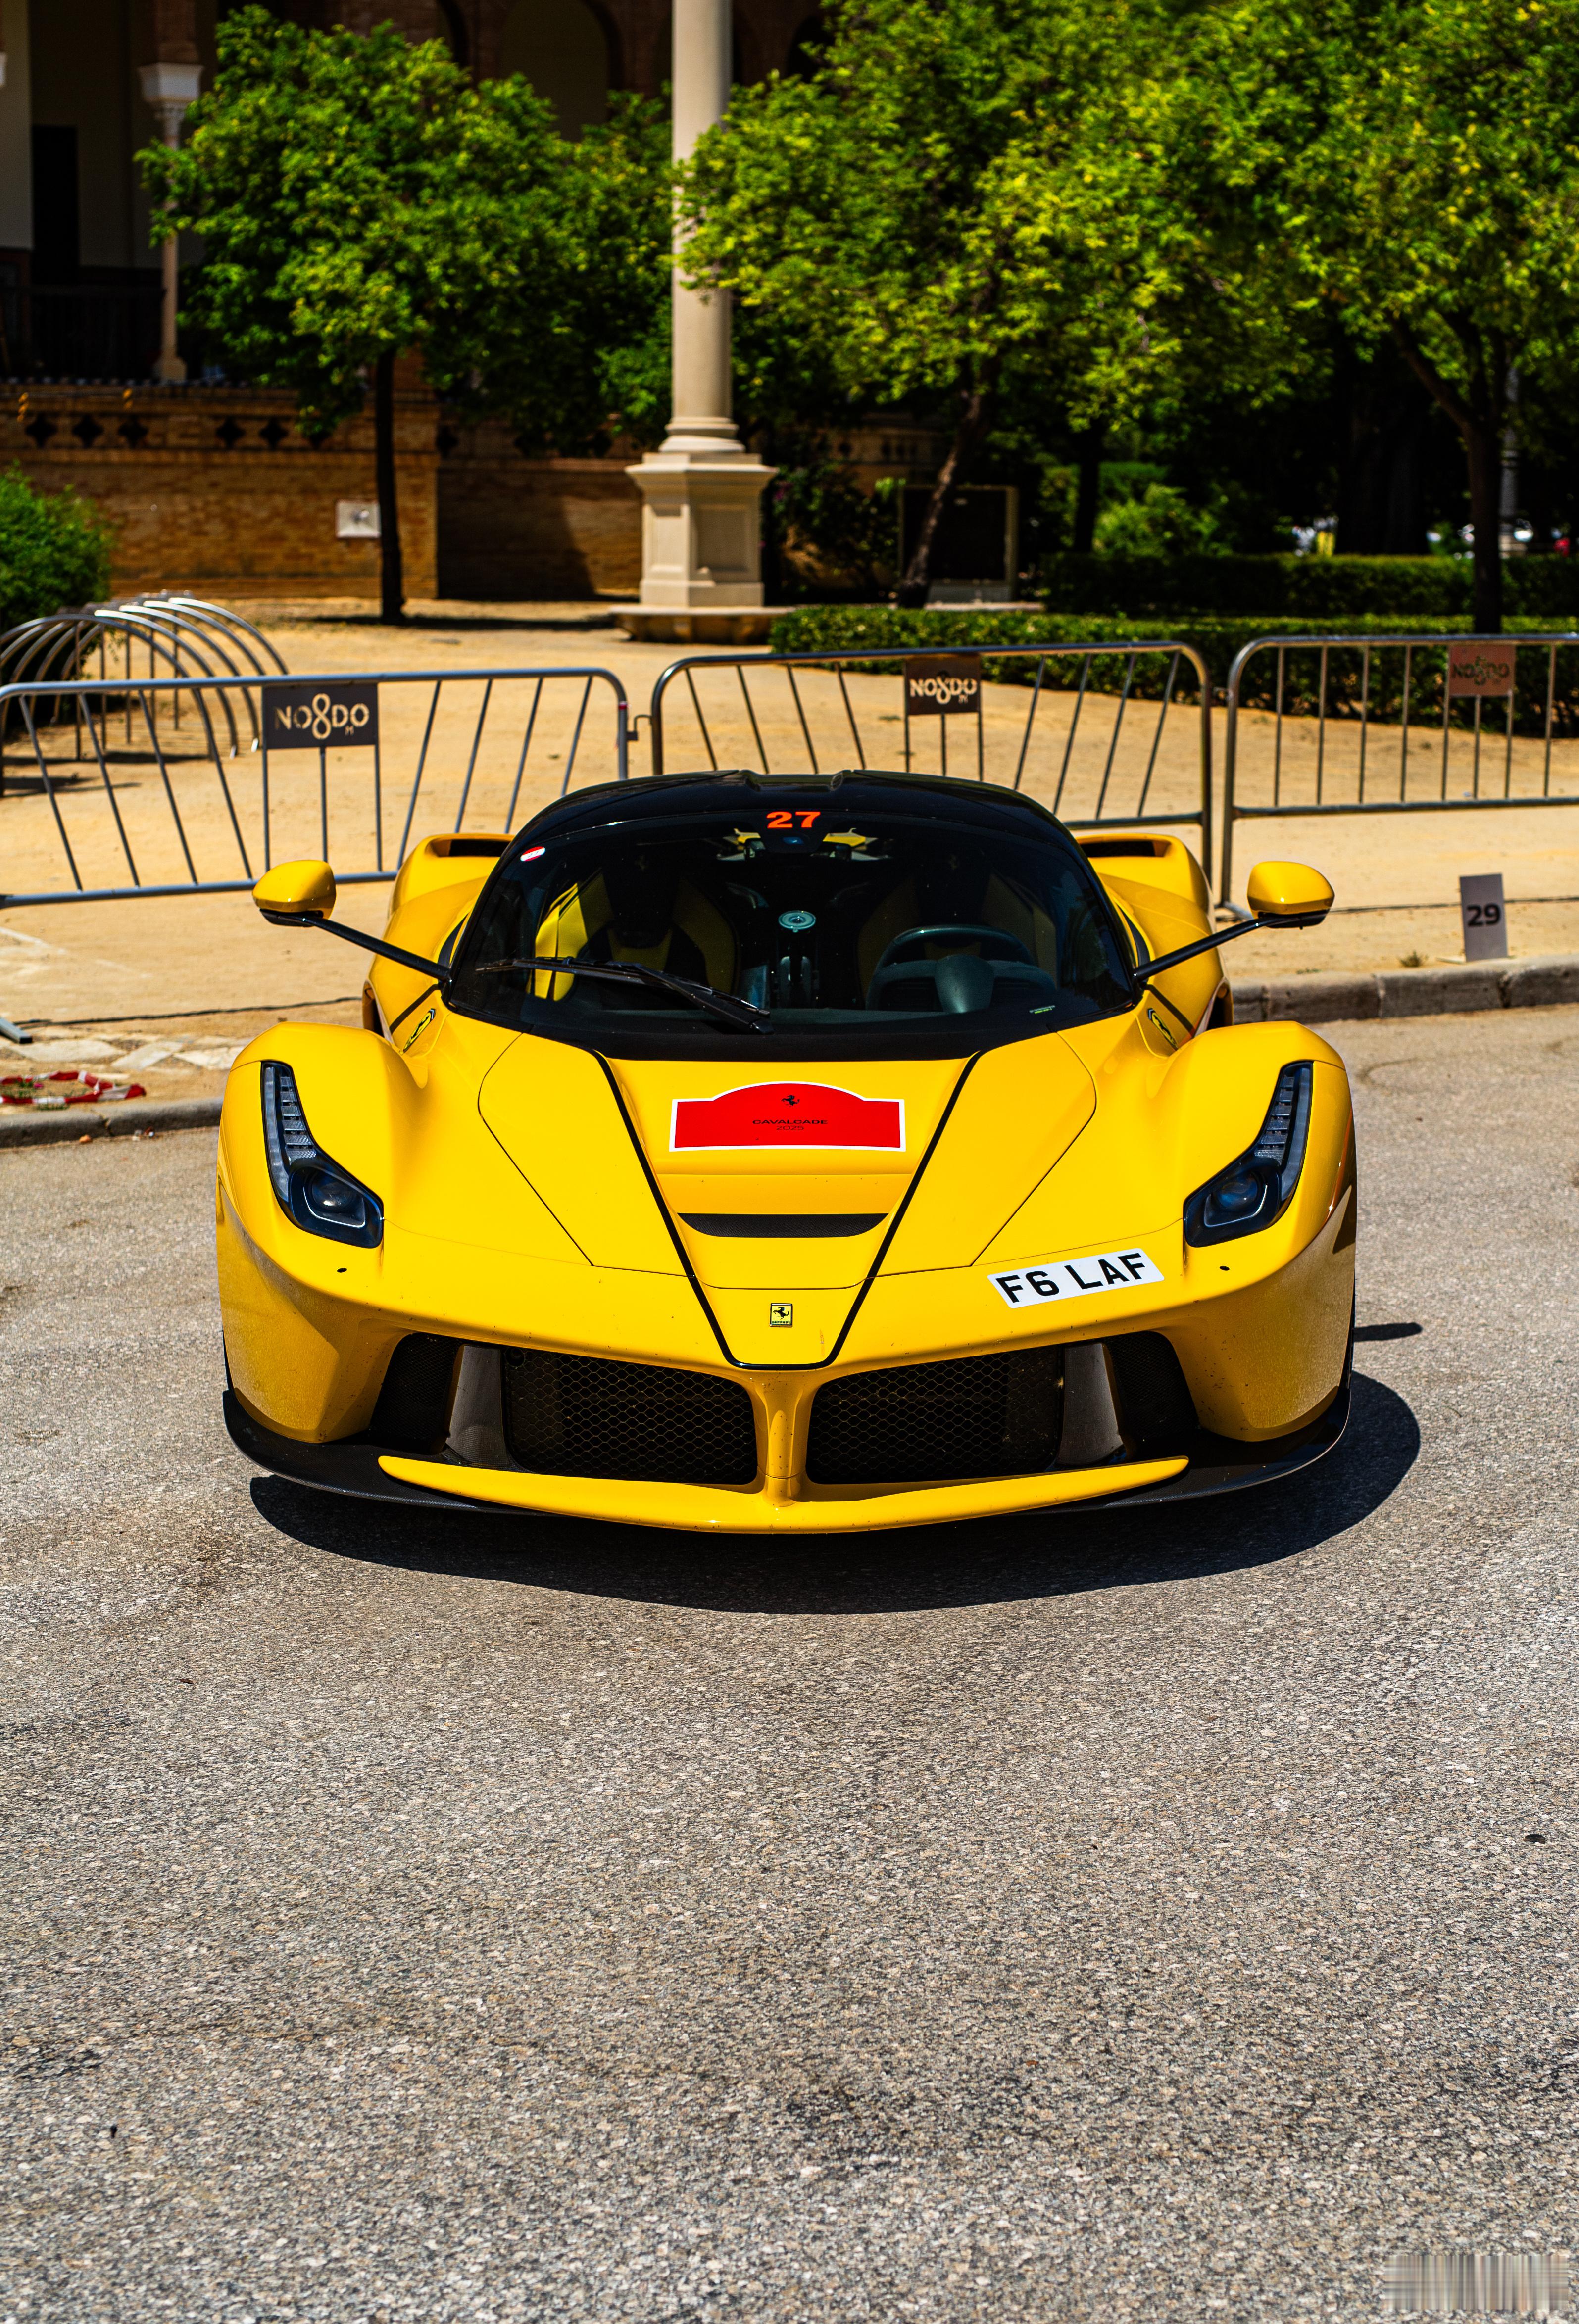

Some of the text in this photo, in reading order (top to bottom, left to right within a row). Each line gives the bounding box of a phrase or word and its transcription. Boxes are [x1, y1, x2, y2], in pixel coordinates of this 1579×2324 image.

[767, 811, 821, 828] 27
[1467, 903, 1501, 927] 29
[995, 1253, 1145, 1303] F6 LAF
